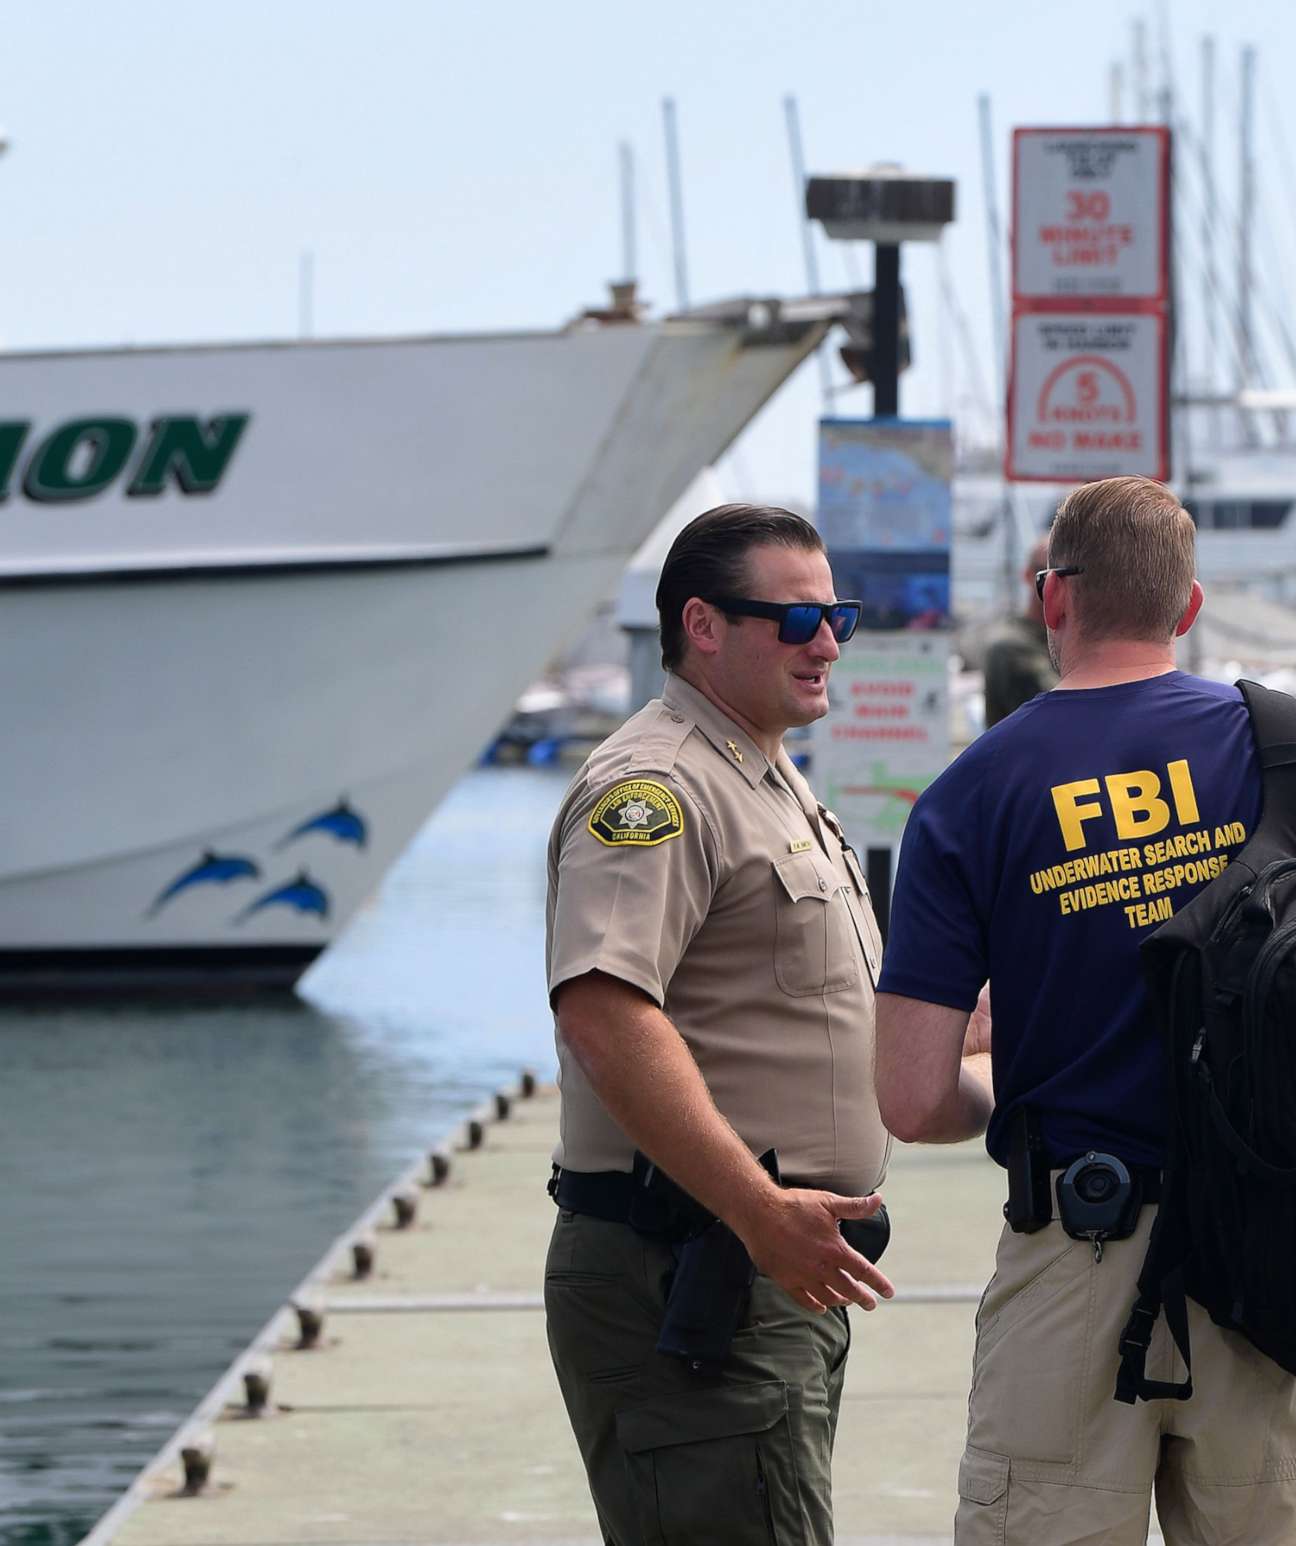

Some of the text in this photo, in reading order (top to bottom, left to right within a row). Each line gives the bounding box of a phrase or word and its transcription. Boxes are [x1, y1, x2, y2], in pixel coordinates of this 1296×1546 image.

[1066, 190, 1111, 222] 30
[1039, 224, 1133, 244] MINUTE
[1052, 243, 1119, 267] LIMIT
[1076, 372, 1100, 403] 5
[1027, 430, 1067, 450] NO
[1050, 758, 1200, 853] FBI
[612, 832, 650, 841] CALIFORNIA
[1030, 821, 1246, 895] UNDERWATER SEARCH AND
[1059, 854, 1230, 915] EVIDENCE RESPONSE
[1123, 897, 1174, 929] TEAM
